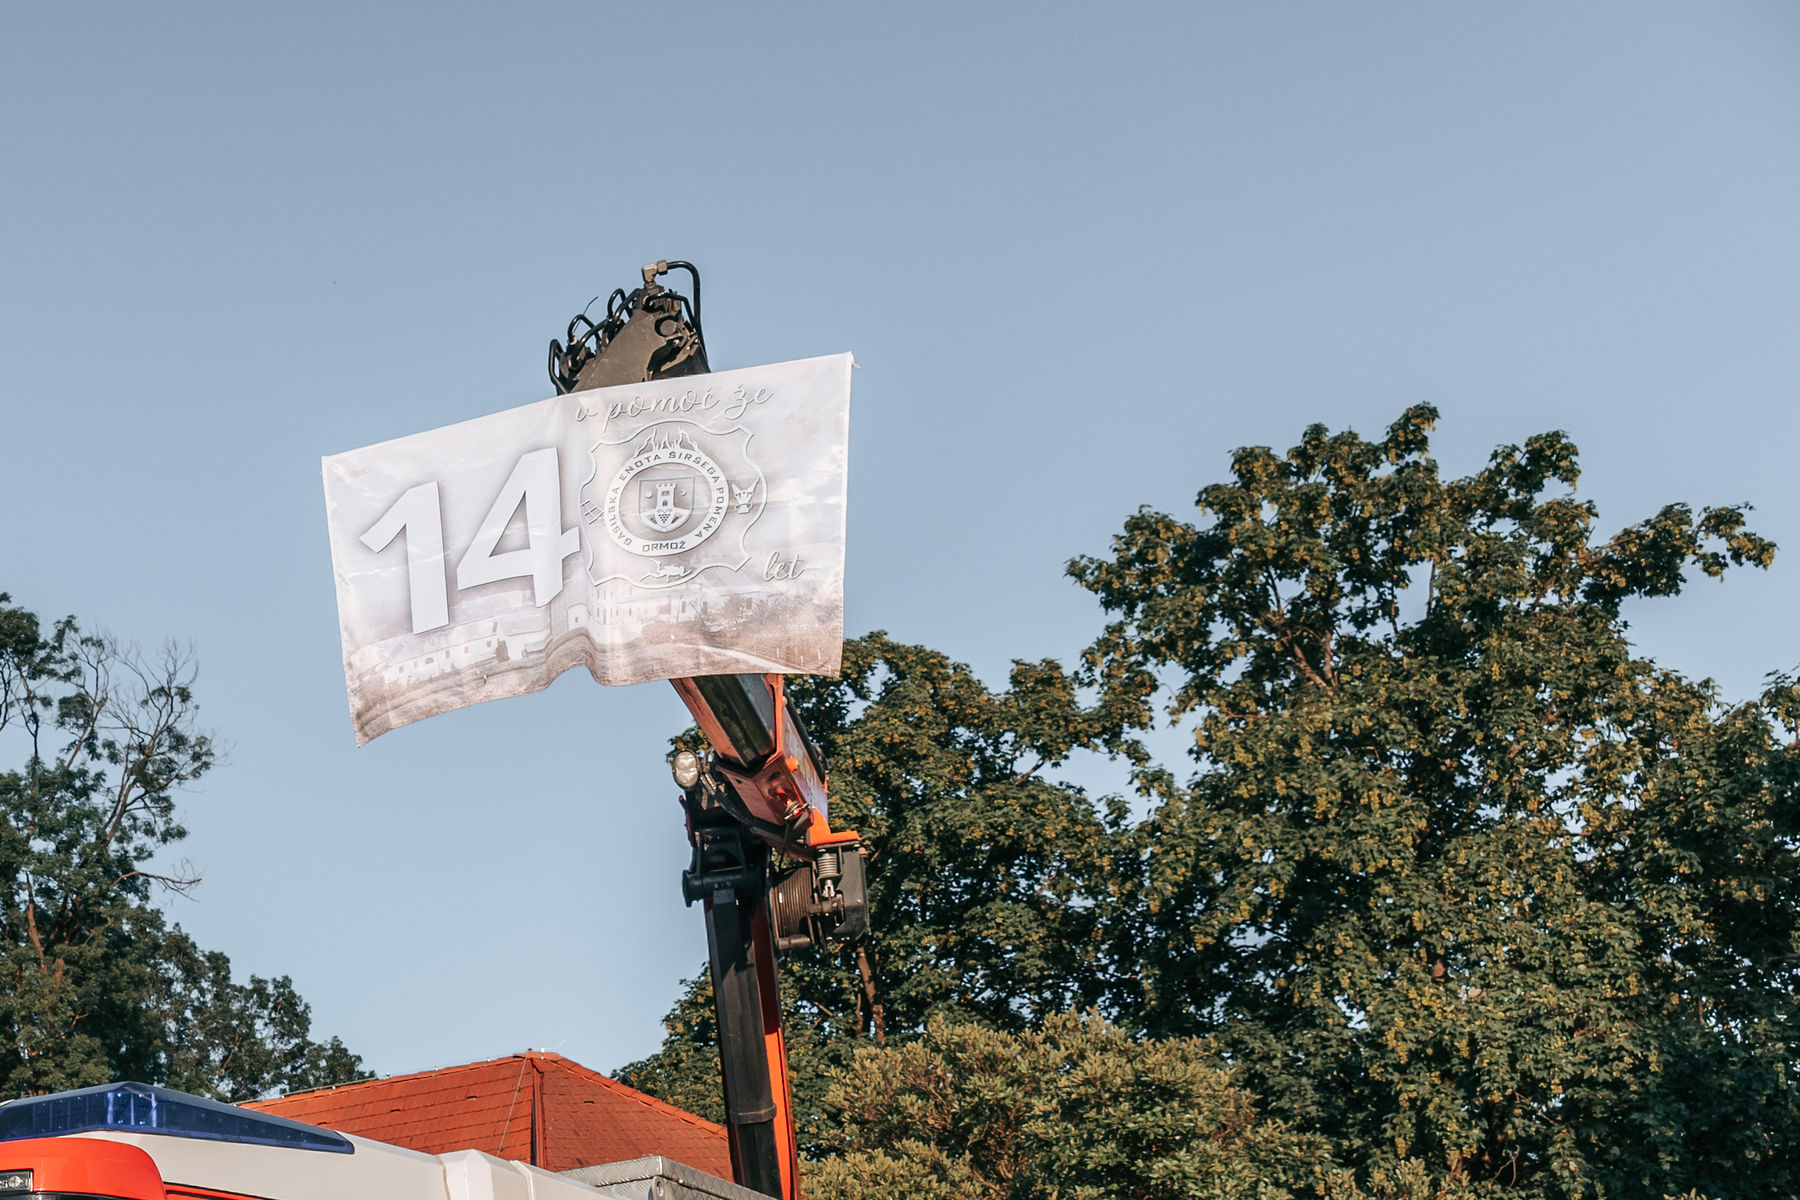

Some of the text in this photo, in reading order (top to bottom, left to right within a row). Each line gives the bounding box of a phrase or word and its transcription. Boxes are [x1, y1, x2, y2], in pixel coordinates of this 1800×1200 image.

[619, 454, 661, 481] ENOTA
[608, 486, 632, 546] GASILSKA
[694, 487, 724, 538] POMENA
[642, 541, 686, 552] ORMOŽ
[763, 551, 808, 582] let
